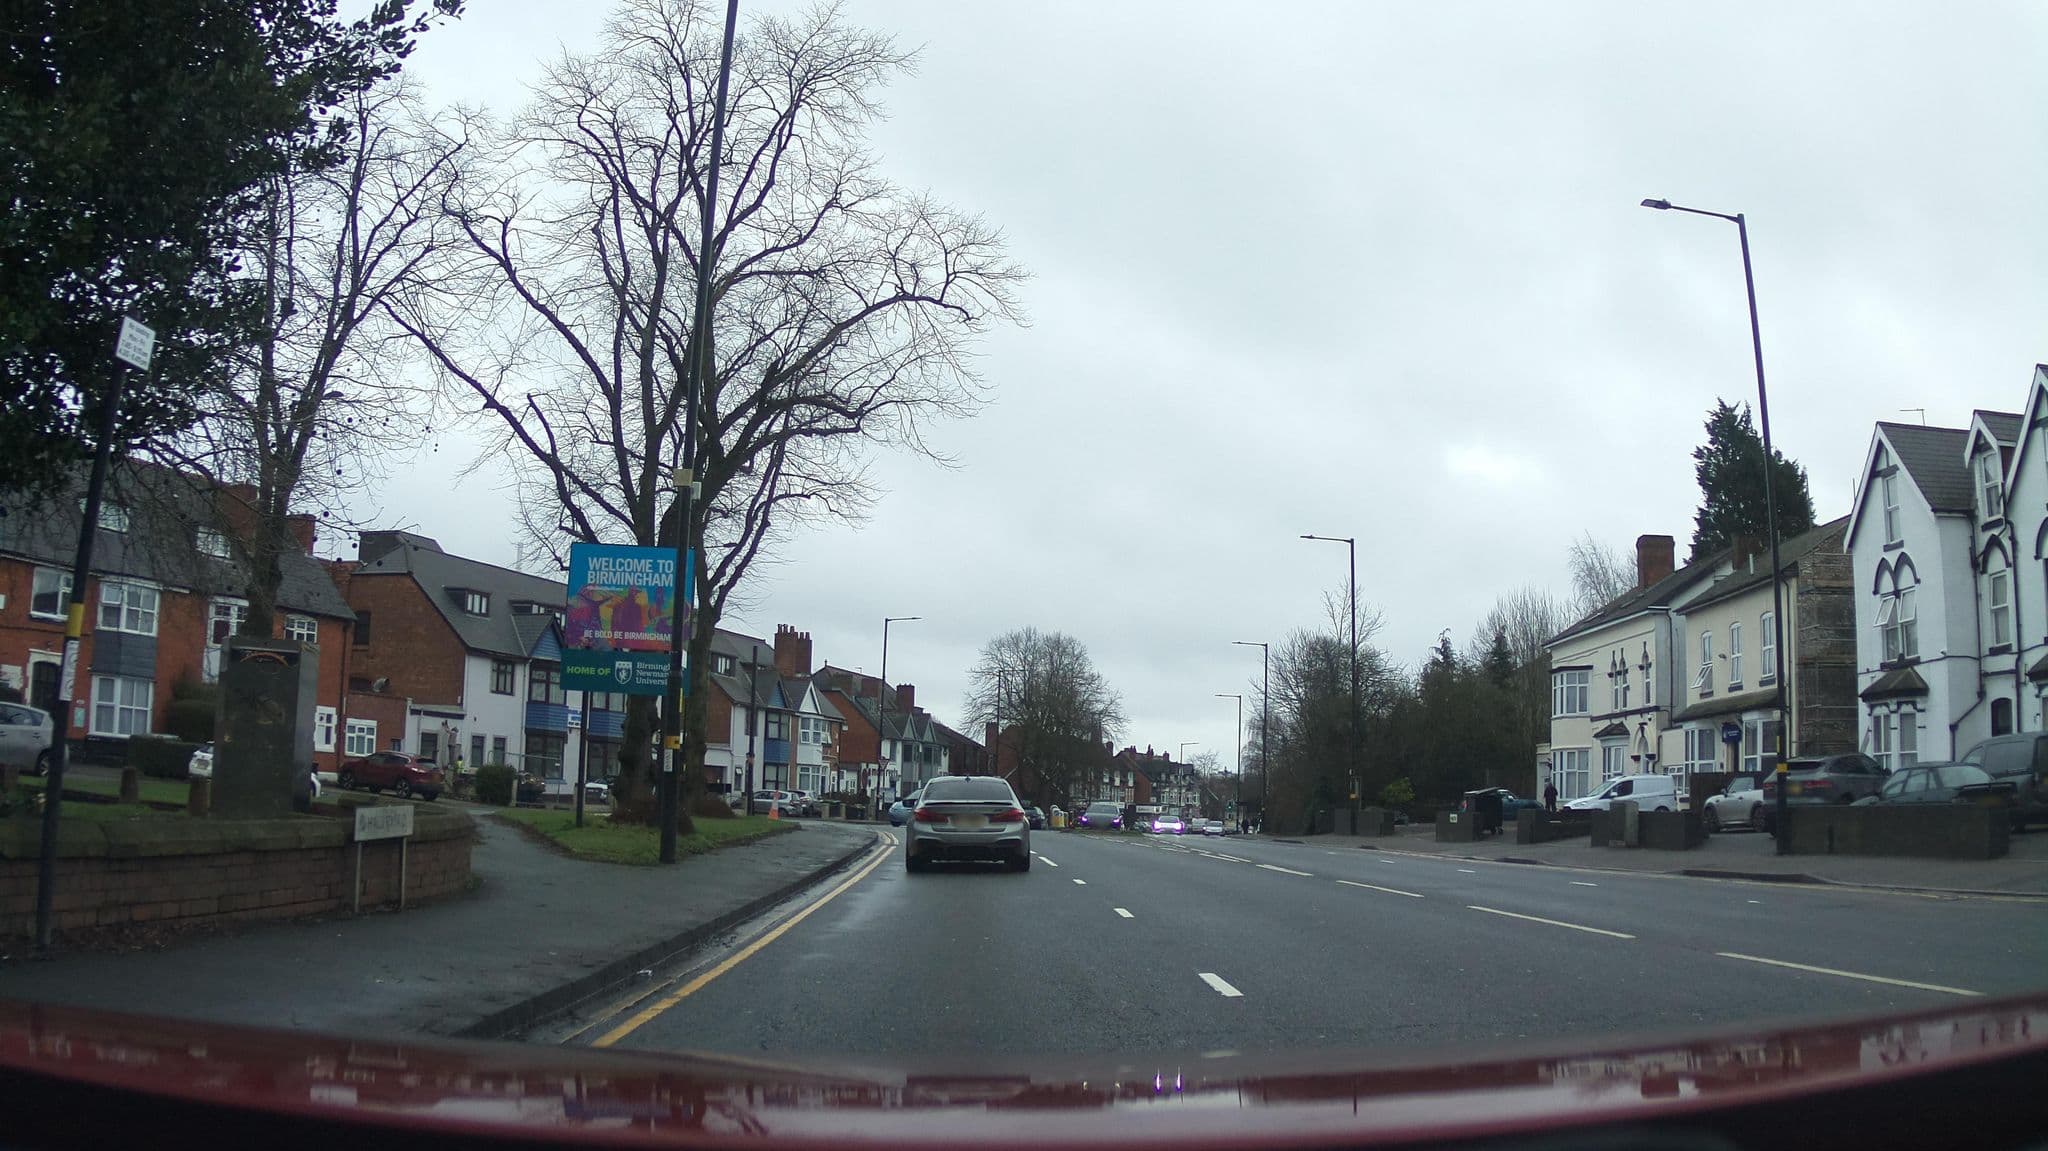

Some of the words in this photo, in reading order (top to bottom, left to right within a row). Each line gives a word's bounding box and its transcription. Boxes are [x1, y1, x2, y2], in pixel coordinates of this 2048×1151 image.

[588, 557, 653, 573] WELCOME
[657, 559, 674, 574] TO
[587, 570, 673, 587] BIRMINGHAM
[584, 629, 593, 639] BE
[594, 630, 613, 639] BOLD
[614, 631, 623, 639] BE
[624, 631, 671, 642] BIRMINGHAM
[566, 665, 596, 675] HOME
[597, 667, 612, 676] OF
